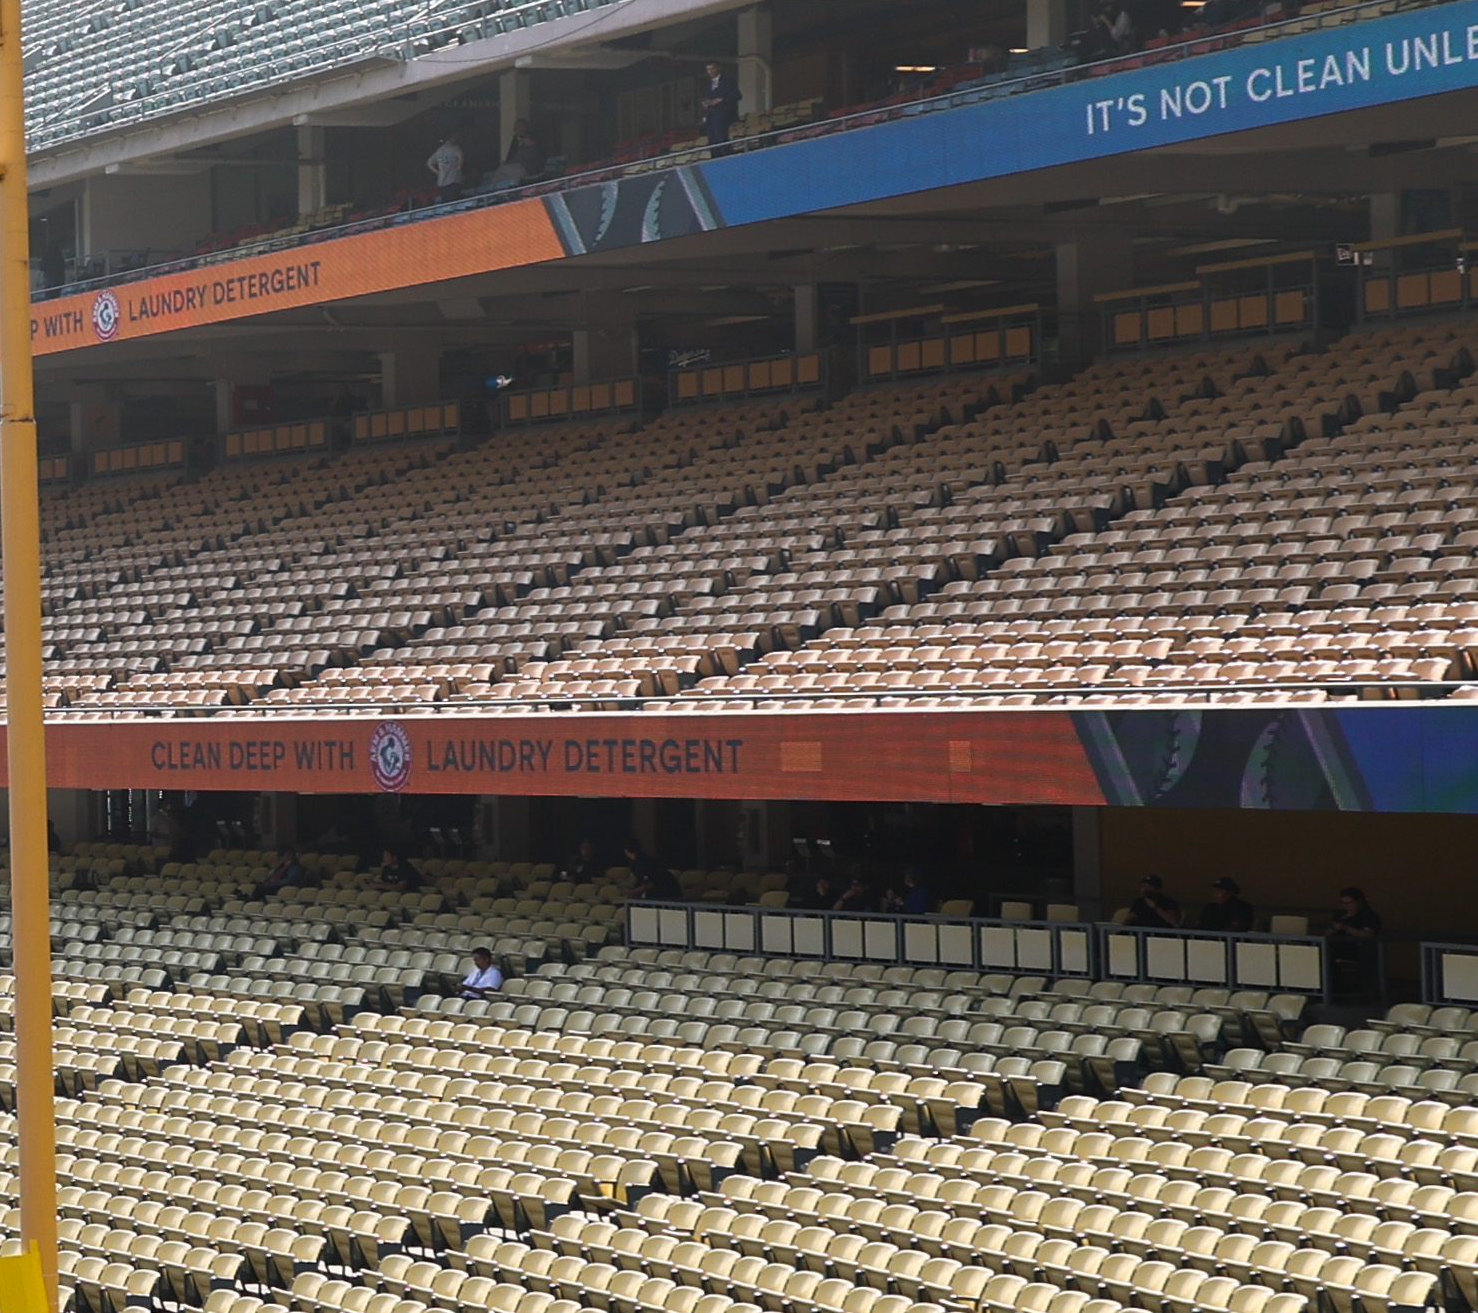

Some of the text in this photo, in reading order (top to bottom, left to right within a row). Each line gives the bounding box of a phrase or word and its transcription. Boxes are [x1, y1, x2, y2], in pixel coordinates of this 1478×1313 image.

[1086, 93, 1147, 135] IT'S
[1160, 75, 1232, 119] NOT
[1247, 47, 1370, 102] CLEAN
[128, 262, 320, 321] LAUNDRY DETERGENT
[45, 310, 83, 337] WITH
[152, 741, 354, 770] CLEAN DEEP WITH
[427, 738, 742, 774] LAUNDRY DETERGENT
